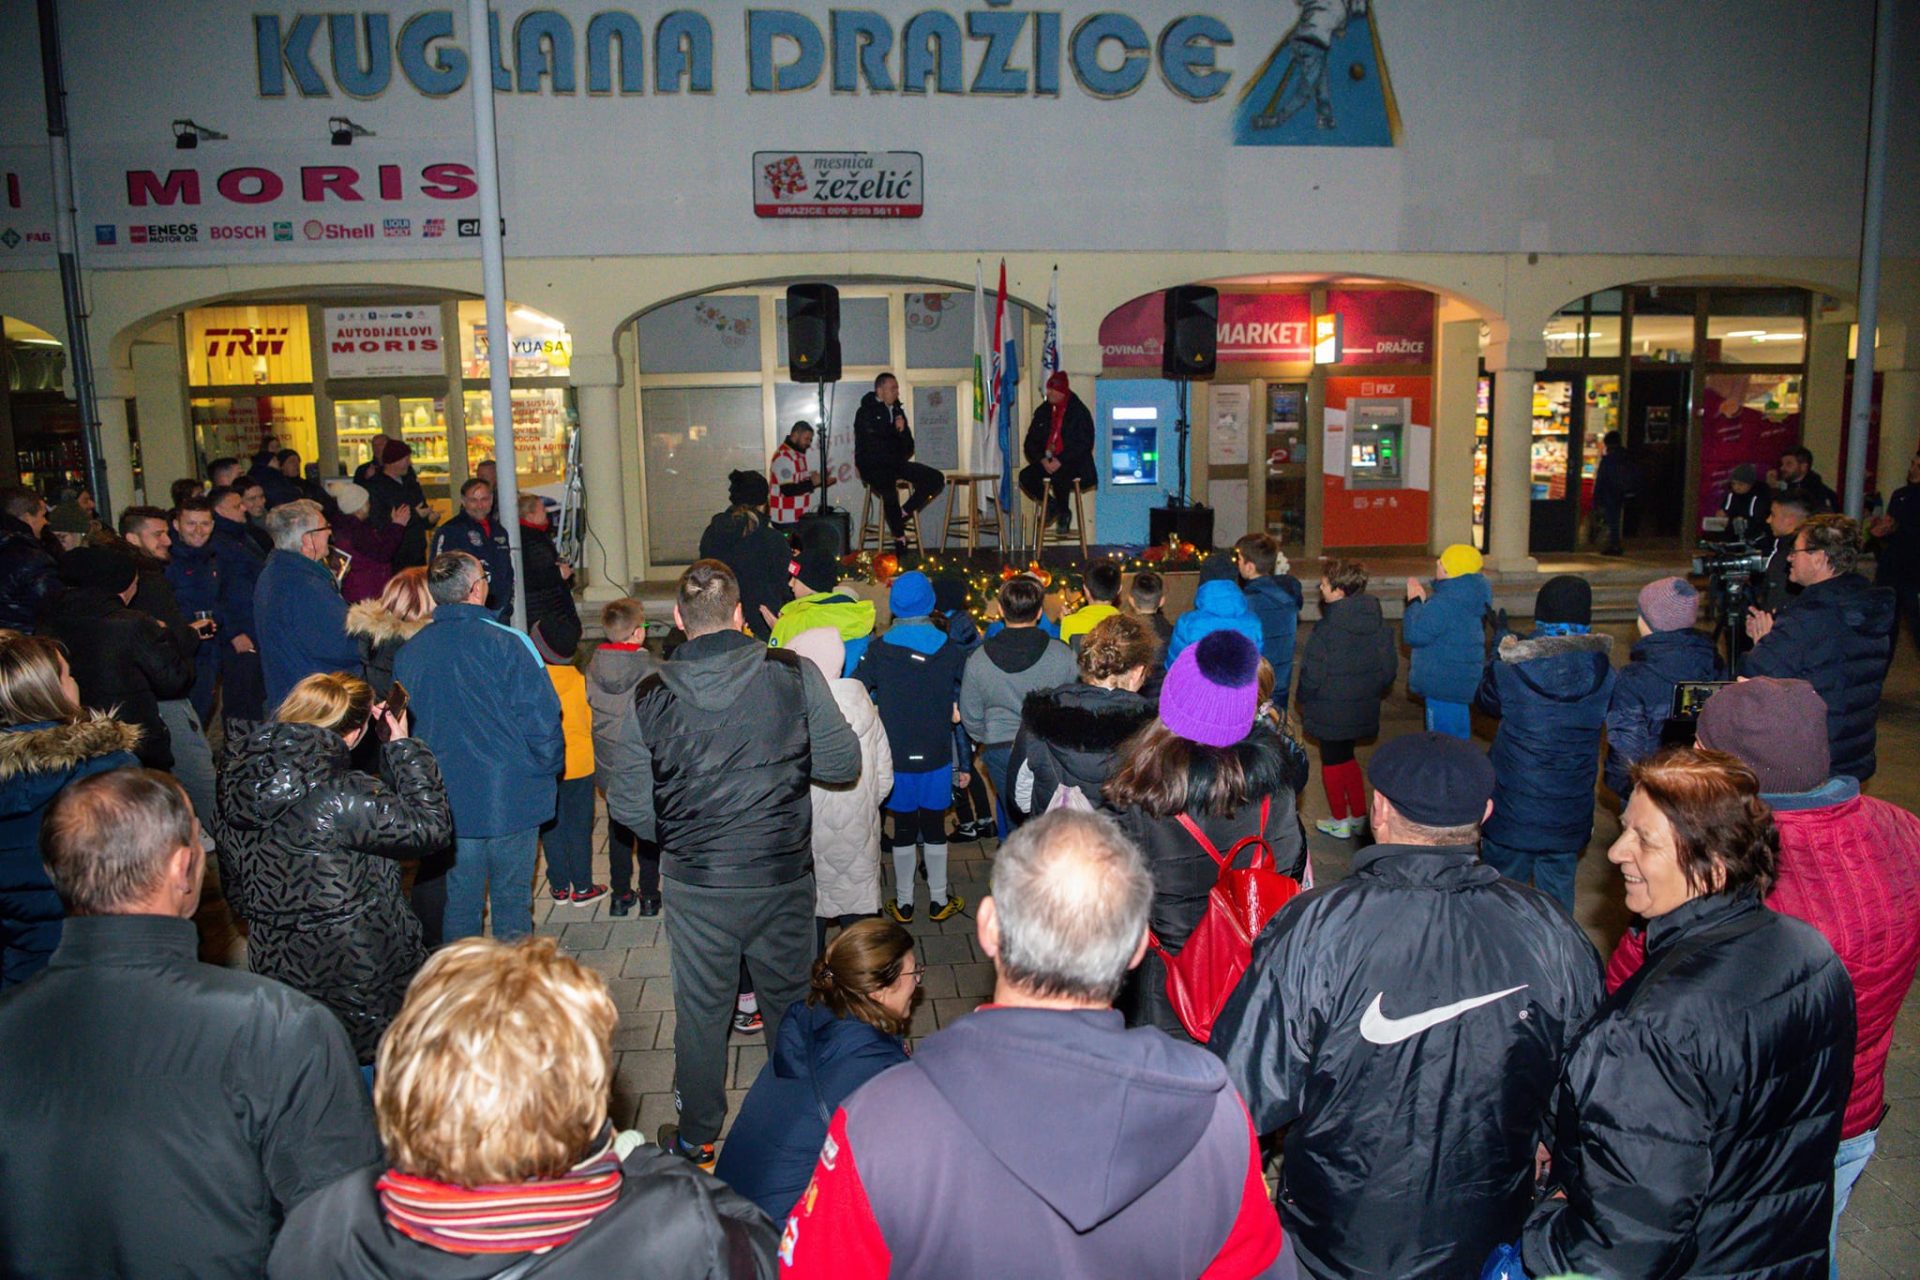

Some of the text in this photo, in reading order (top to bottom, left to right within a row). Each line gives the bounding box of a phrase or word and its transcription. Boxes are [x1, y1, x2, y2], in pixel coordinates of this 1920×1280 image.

[256, 0, 1235, 101] KUGLANA DRAŽICE
[813, 153, 873, 169] mesnica
[126, 163, 479, 206] MORIS
[813, 170, 912, 200] žeželić
[148, 224, 198, 236] ENEOS
[210, 226, 266, 239] BOSCH
[326, 224, 374, 239] Shell
[26, 233, 51, 242] FAG
[149, 235, 182, 243] MOTOR
[337, 326, 432, 338] AUTODIJELOVI
[1216, 322, 1308, 345] MARKET
[205, 328, 288, 357] TRW
[332, 339, 438, 353] MORIS
[512, 341, 564, 353] YUASA
[1105, 345, 1145, 354] OVINA
[1375, 339, 1425, 354] DRAŽICE
[1376, 384, 1396, 394] PBZ
